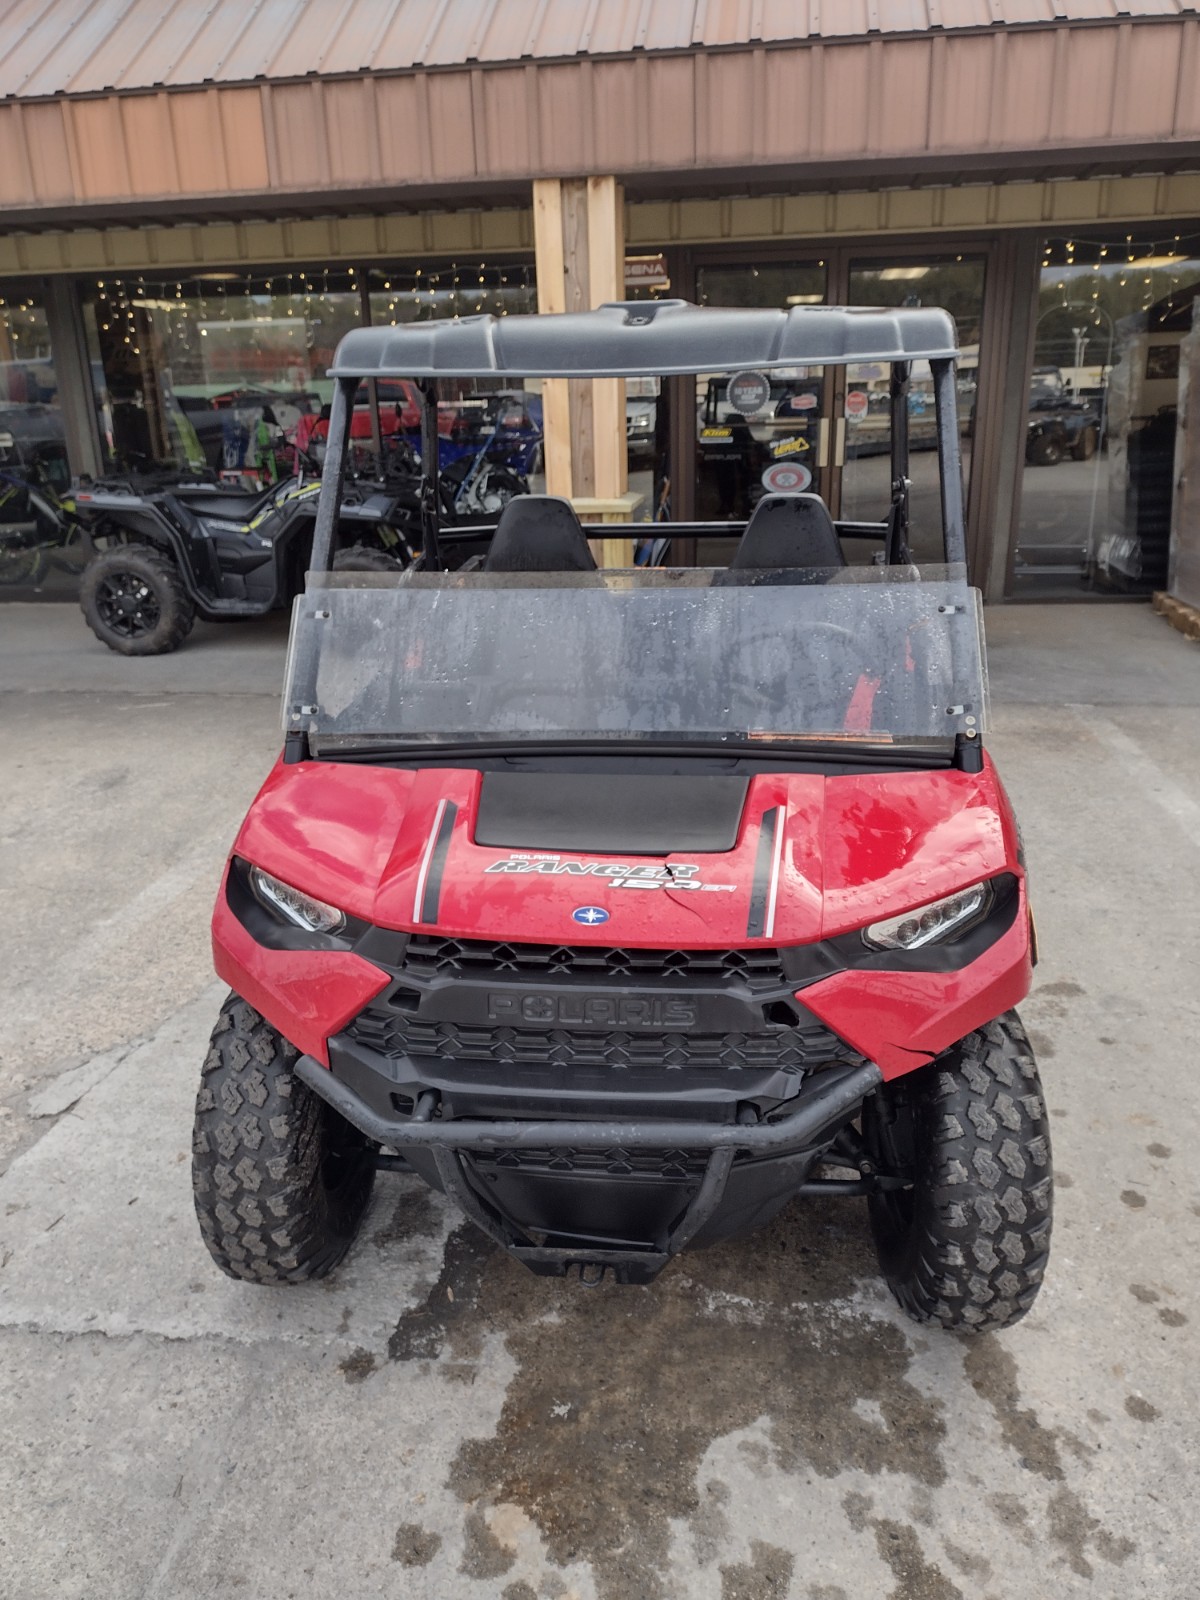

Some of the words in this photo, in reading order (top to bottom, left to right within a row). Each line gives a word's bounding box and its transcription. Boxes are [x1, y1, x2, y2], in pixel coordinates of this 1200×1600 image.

[485, 860, 699, 879] RANGER
[608, 878, 702, 891] 150
[701, 884, 737, 892] EFI
[488, 993, 697, 1026] POLARIS
